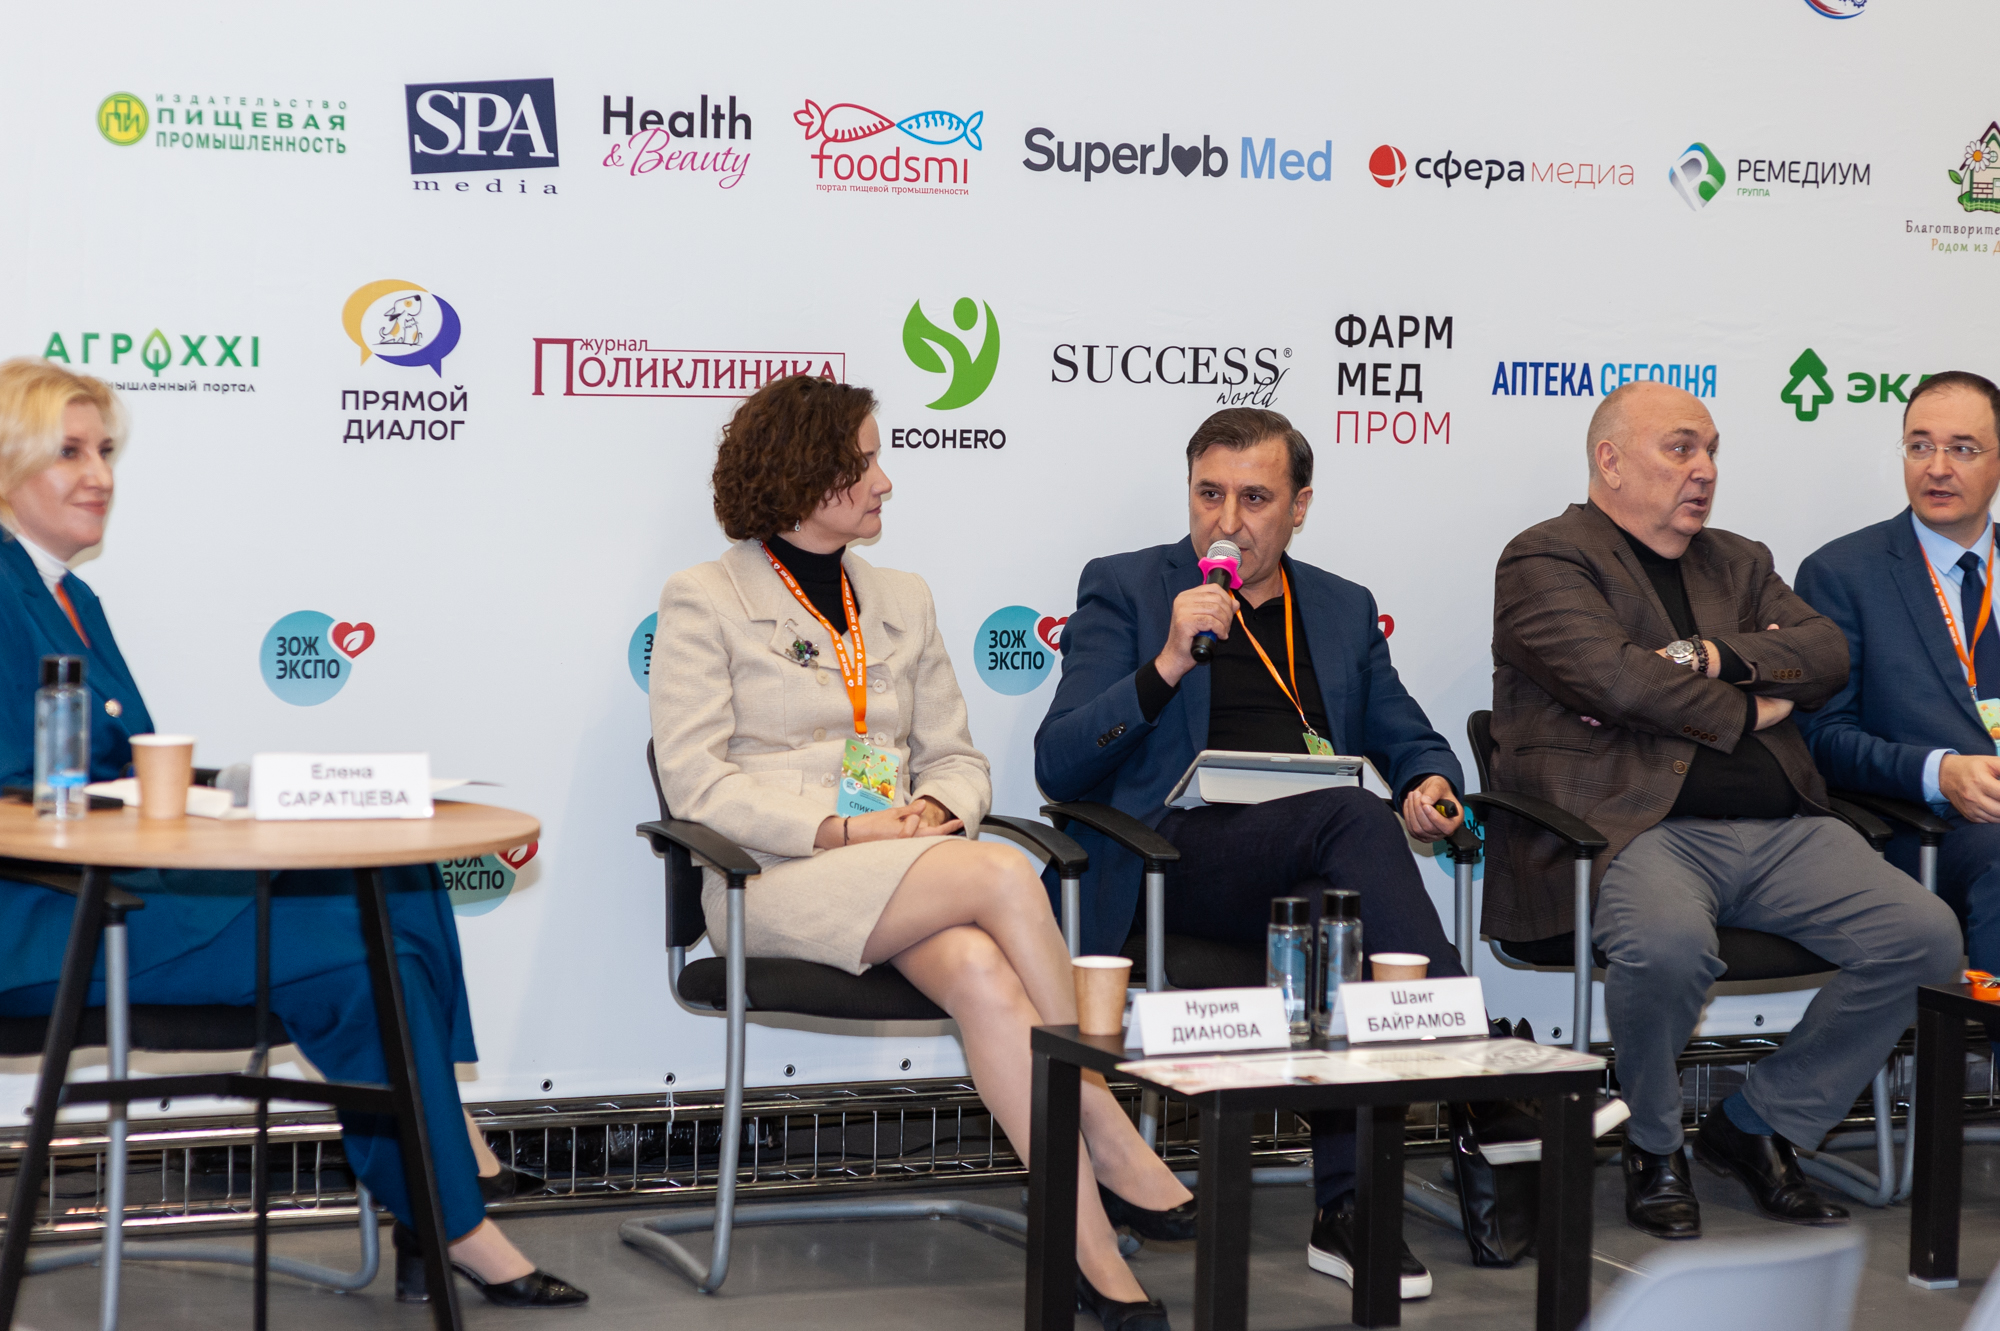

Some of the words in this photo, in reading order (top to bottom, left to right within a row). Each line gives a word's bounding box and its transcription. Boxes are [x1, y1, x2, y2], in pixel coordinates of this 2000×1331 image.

[155, 93, 347, 110] ИЗДАТЕЛЬСТВО
[157, 107, 346, 131] ПИЩЕВАЯ
[414, 89, 555, 158] SPA
[603, 94, 751, 140] Health
[155, 130, 347, 154] ПРОМЫШЛЕННОСТЬ
[602, 143, 625, 167] &
[628, 127, 751, 189] Beauty
[810, 140, 968, 184] foodsmi
[1240, 137, 1333, 182] Med
[1414, 150, 1525, 189] сфера
[1531, 161, 1635, 189] медиа
[1737, 158, 1871, 189] РЕМЕДИУМ
[412, 178, 558, 195] media
[815, 183, 848, 193] портал
[849, 184, 889, 193] пищевой
[891, 186, 969, 196] промышленности
[1736, 187, 1771, 197] ГРУППА
[1931, 238, 1969, 254] Родом
[1973, 243, 1988, 253] из
[1334, 313, 1454, 350] ФАРМ
[579, 338, 648, 355] журнал
[203, 381, 256, 395] портал
[1216, 367, 1291, 408] world
[1337, 362, 1423, 403] МЕД
[1491, 361, 1595, 397] АПТЕКА
[341, 384, 468, 412] ПРЯМОЙ
[342, 418, 466, 444] ДИАЛОГ
[891, 427, 1007, 450] ECOHERO
[1336, 410, 1451, 445] ПРОМ
[276, 636, 320, 657] ЗОЖ
[988, 629, 1027, 649] ЗОЖ
[275, 658, 341, 680] ЭКСПО
[987, 650, 1045, 671] ЭКСПО
[311, 763, 374, 780] Елена
[277, 789, 410, 808] САРАТЦЕВА
[849, 800, 875, 813] СПИК
[442, 869, 505, 891] ЭКСПО
[1185, 1000, 1240, 1018] Нурия
[1390, 990, 1435, 1006] Шаиг
[1172, 1022, 1262, 1044] ДИАНОВА
[1367, 1011, 1466, 1033] БАЙРАМОВ
